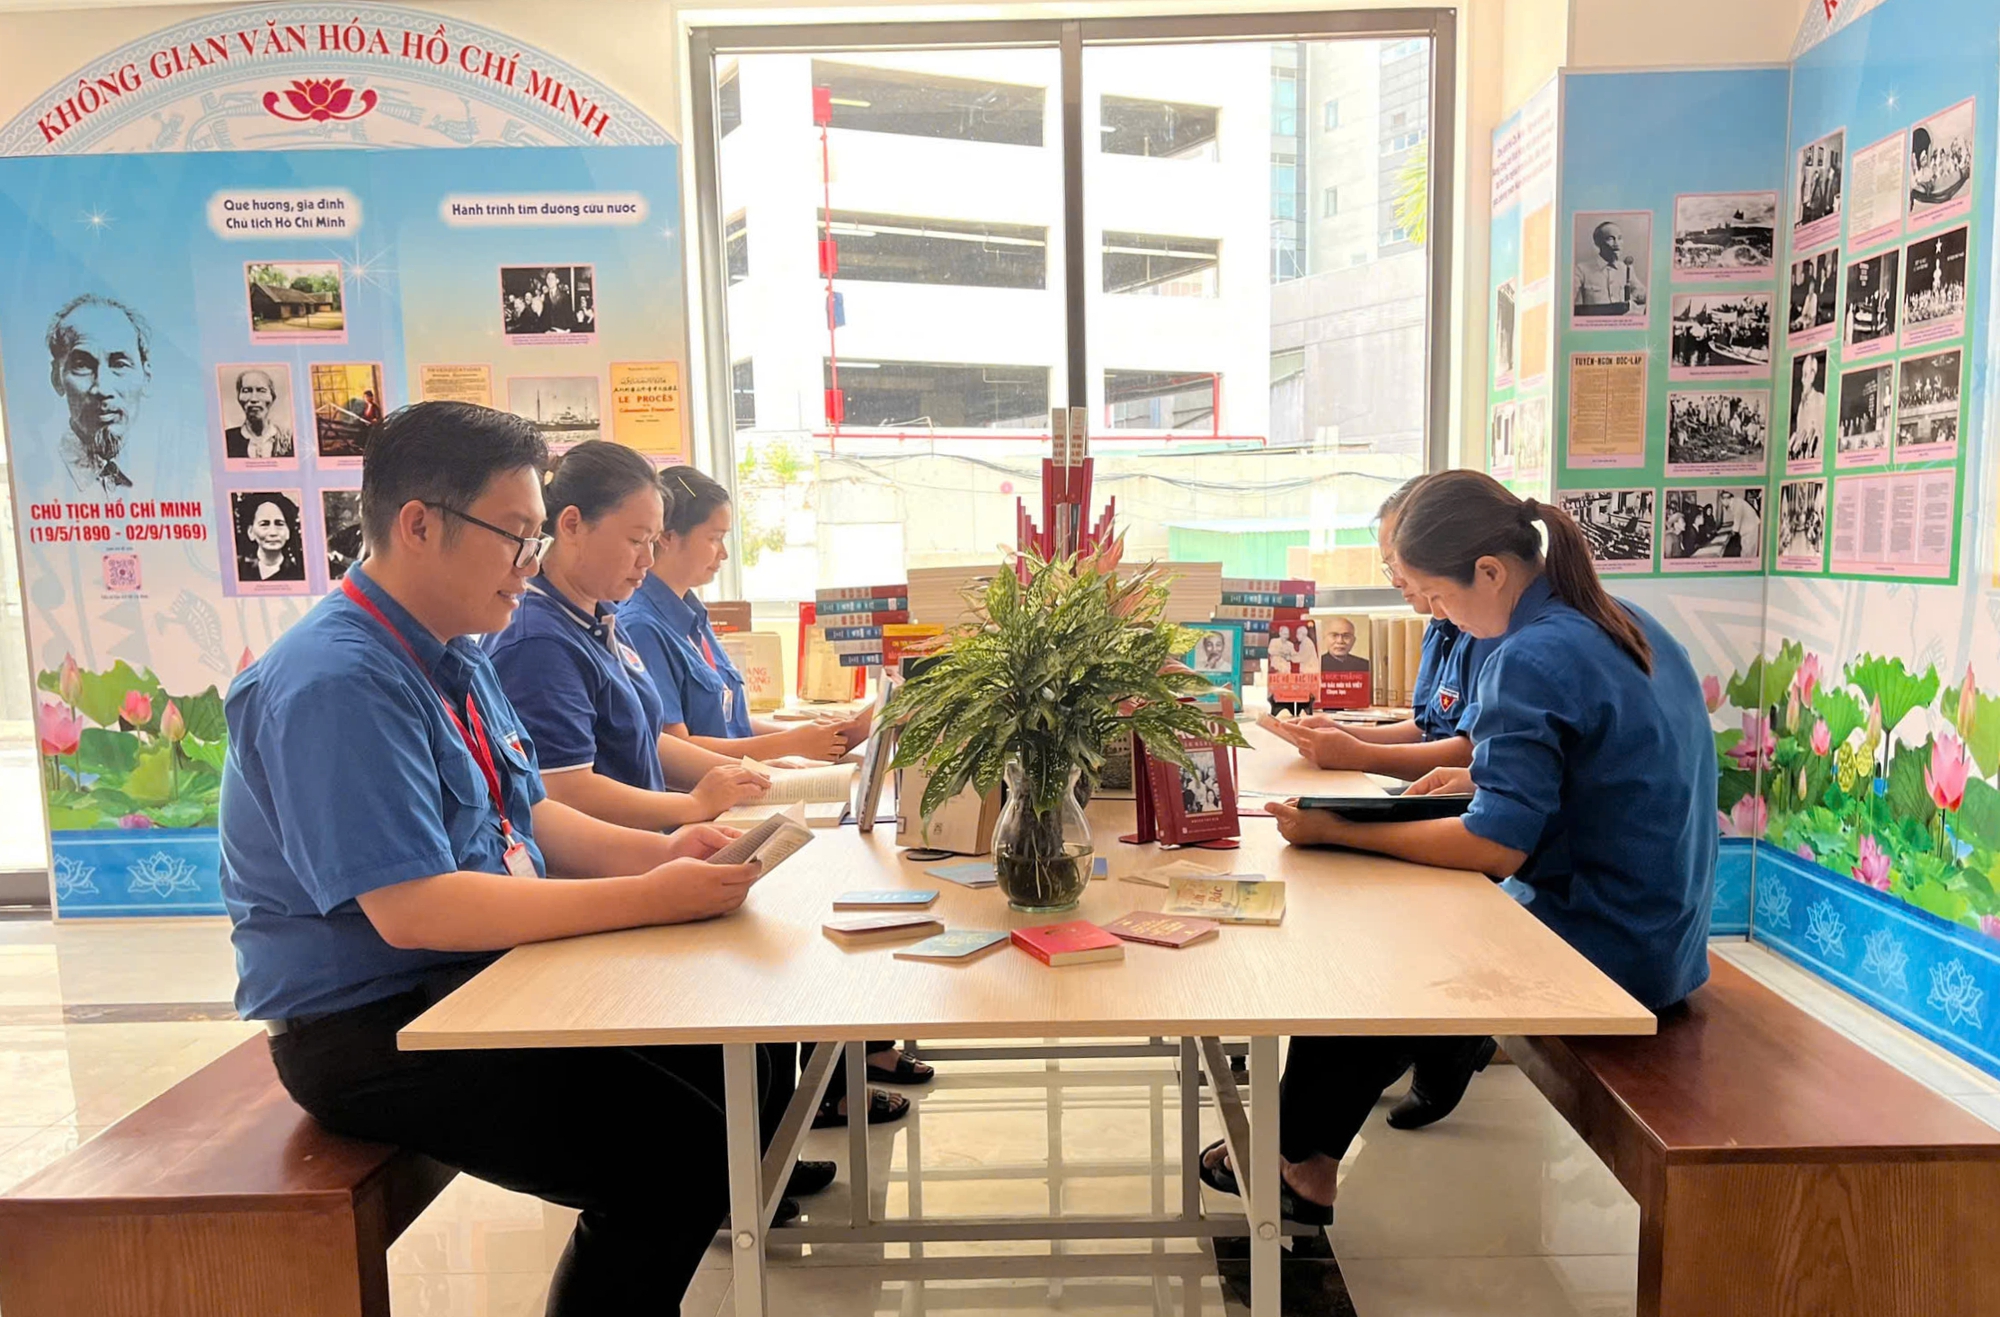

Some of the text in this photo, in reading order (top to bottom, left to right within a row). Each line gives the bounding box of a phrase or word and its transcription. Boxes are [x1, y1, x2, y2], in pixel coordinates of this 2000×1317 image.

[37, 17, 610, 144] KHÔNG GIAN VĂN HÓA HỒ CHÍ MINH
[296, 199, 315, 213] gia
[315, 216, 346, 228] Minh
[30, 498, 62, 520] CHỦ
[66, 503, 101, 523] TỊCH
[129, 499, 156, 519] CHÍ
[160, 501, 202, 518] MINH
[30, 525, 111, 543] (19/5/1890
[125, 523, 208, 541] 02/9/1969)
